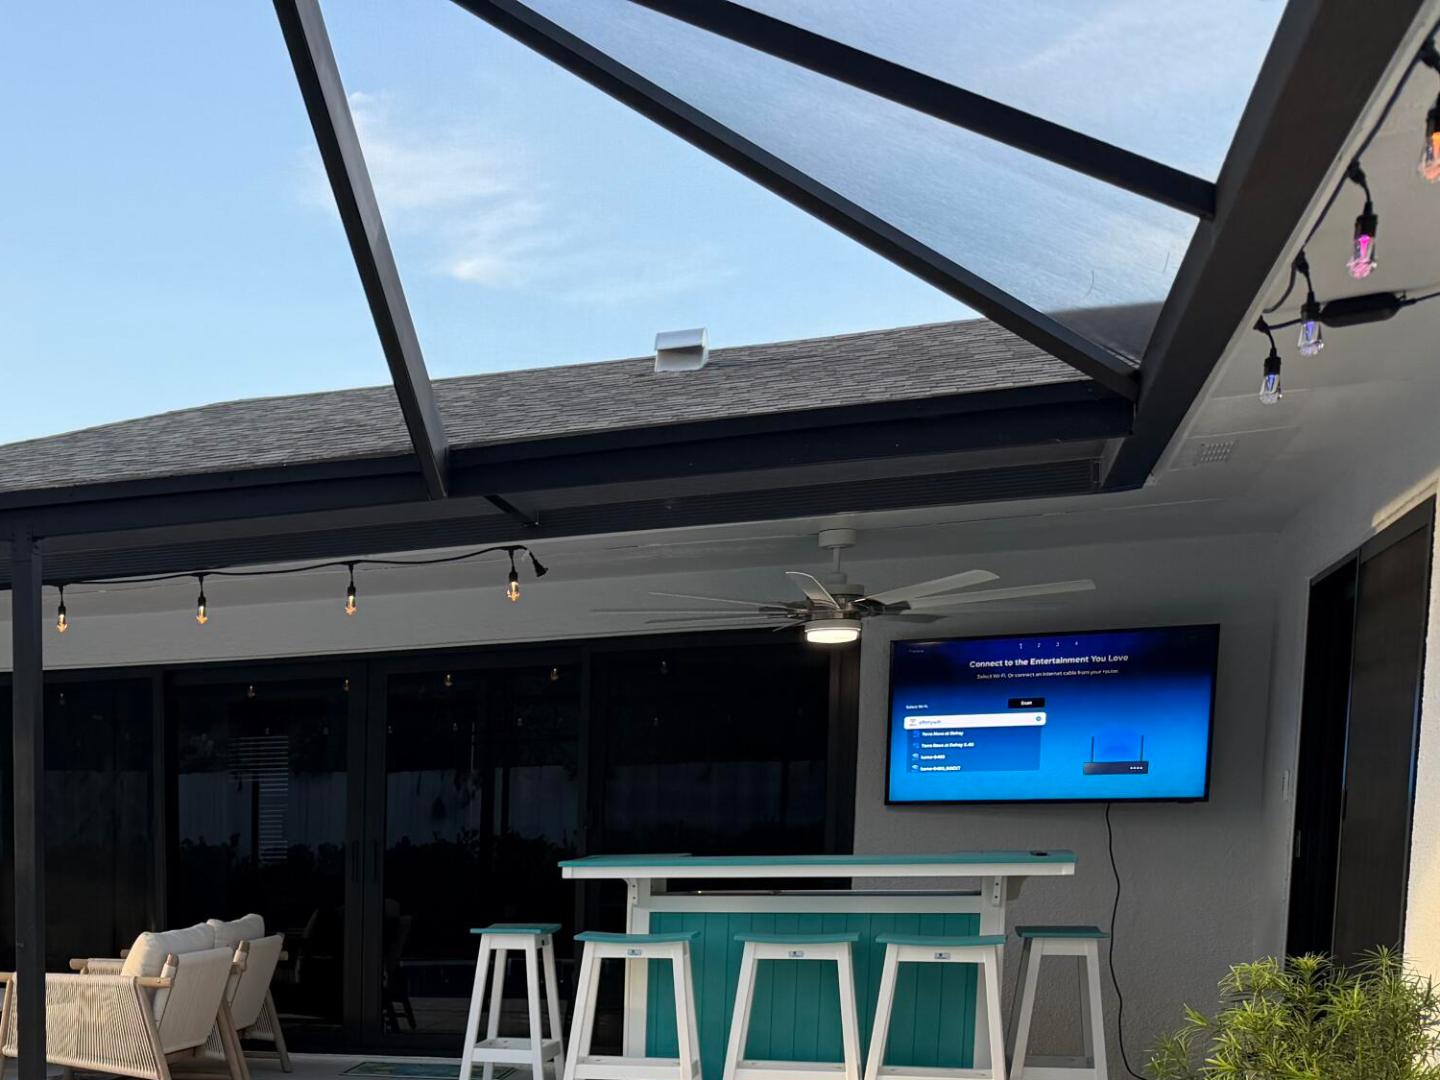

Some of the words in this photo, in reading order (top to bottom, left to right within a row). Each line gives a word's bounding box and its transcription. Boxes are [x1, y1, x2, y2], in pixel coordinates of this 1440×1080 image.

[969, 659, 1003, 668] Connect
[1014, 658, 1029, 666] the
[1030, 656, 1089, 665] Entertainment
[1090, 655, 1107, 663] You
